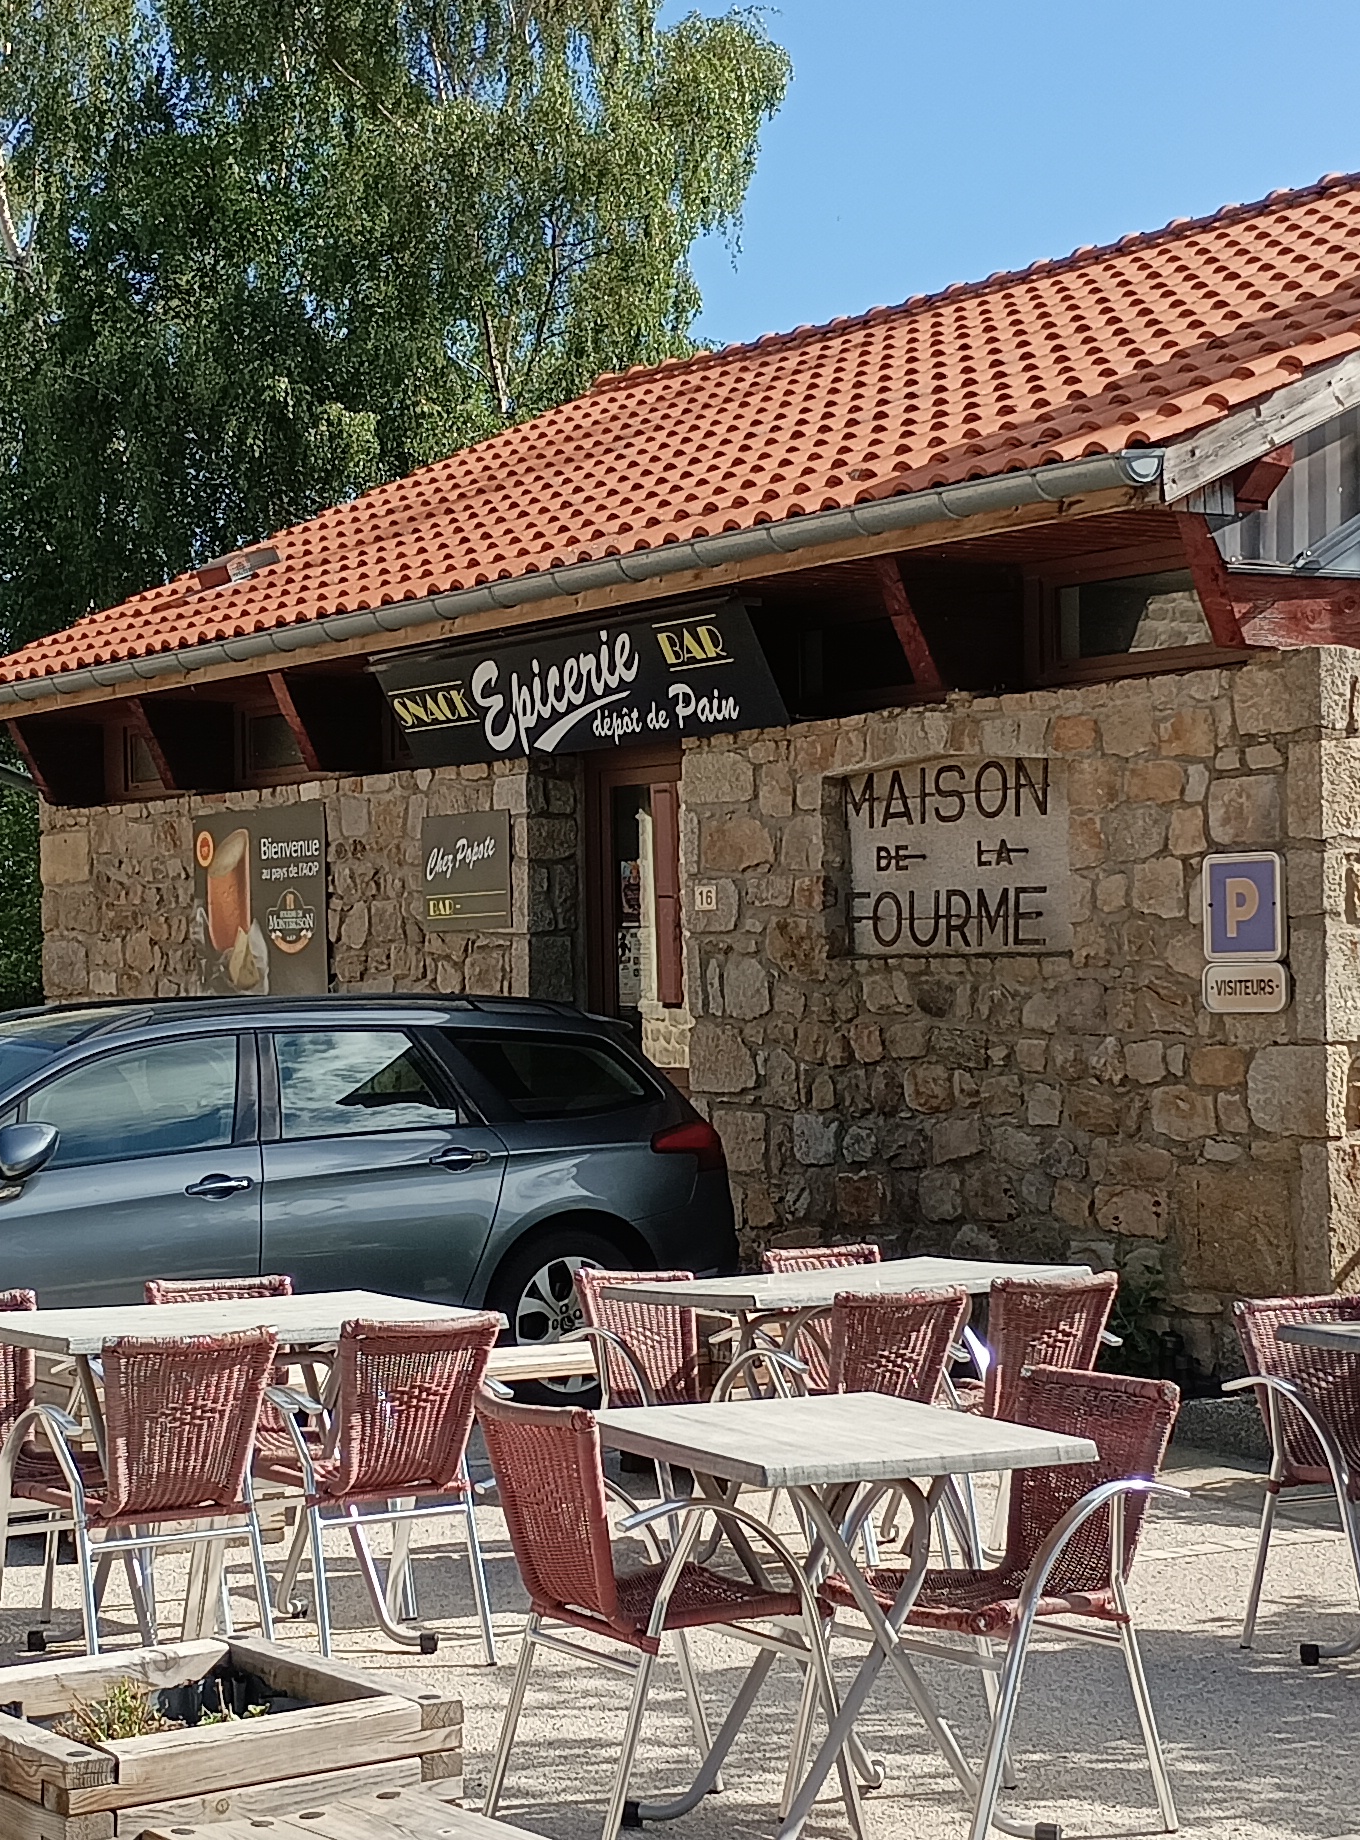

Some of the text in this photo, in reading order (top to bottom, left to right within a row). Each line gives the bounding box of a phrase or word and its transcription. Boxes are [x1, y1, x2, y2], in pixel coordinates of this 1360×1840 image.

[655, 625, 728, 665] BAR
[392, 687, 478, 728] SNACK
[471, 629, 639, 755] Epicerie
[591, 683, 740, 746] dépôt de Pain
[842, 756, 1050, 830] MAISON
[260, 837, 320, 860] Bienvenue
[426, 846, 454, 881] Chez
[875, 838, 1014, 872] DE LA
[261, 868, 271, 880] au
[272, 867, 288, 881] pays
[288, 863, 299, 878] de
[429, 899, 454, 916] BAR
[698, 888, 713, 907] 16
[1225, 877, 1259, 938] P
[847, 885, 1048, 948] FOURME
[1214, 978, 1275, 997] VISITEURS
